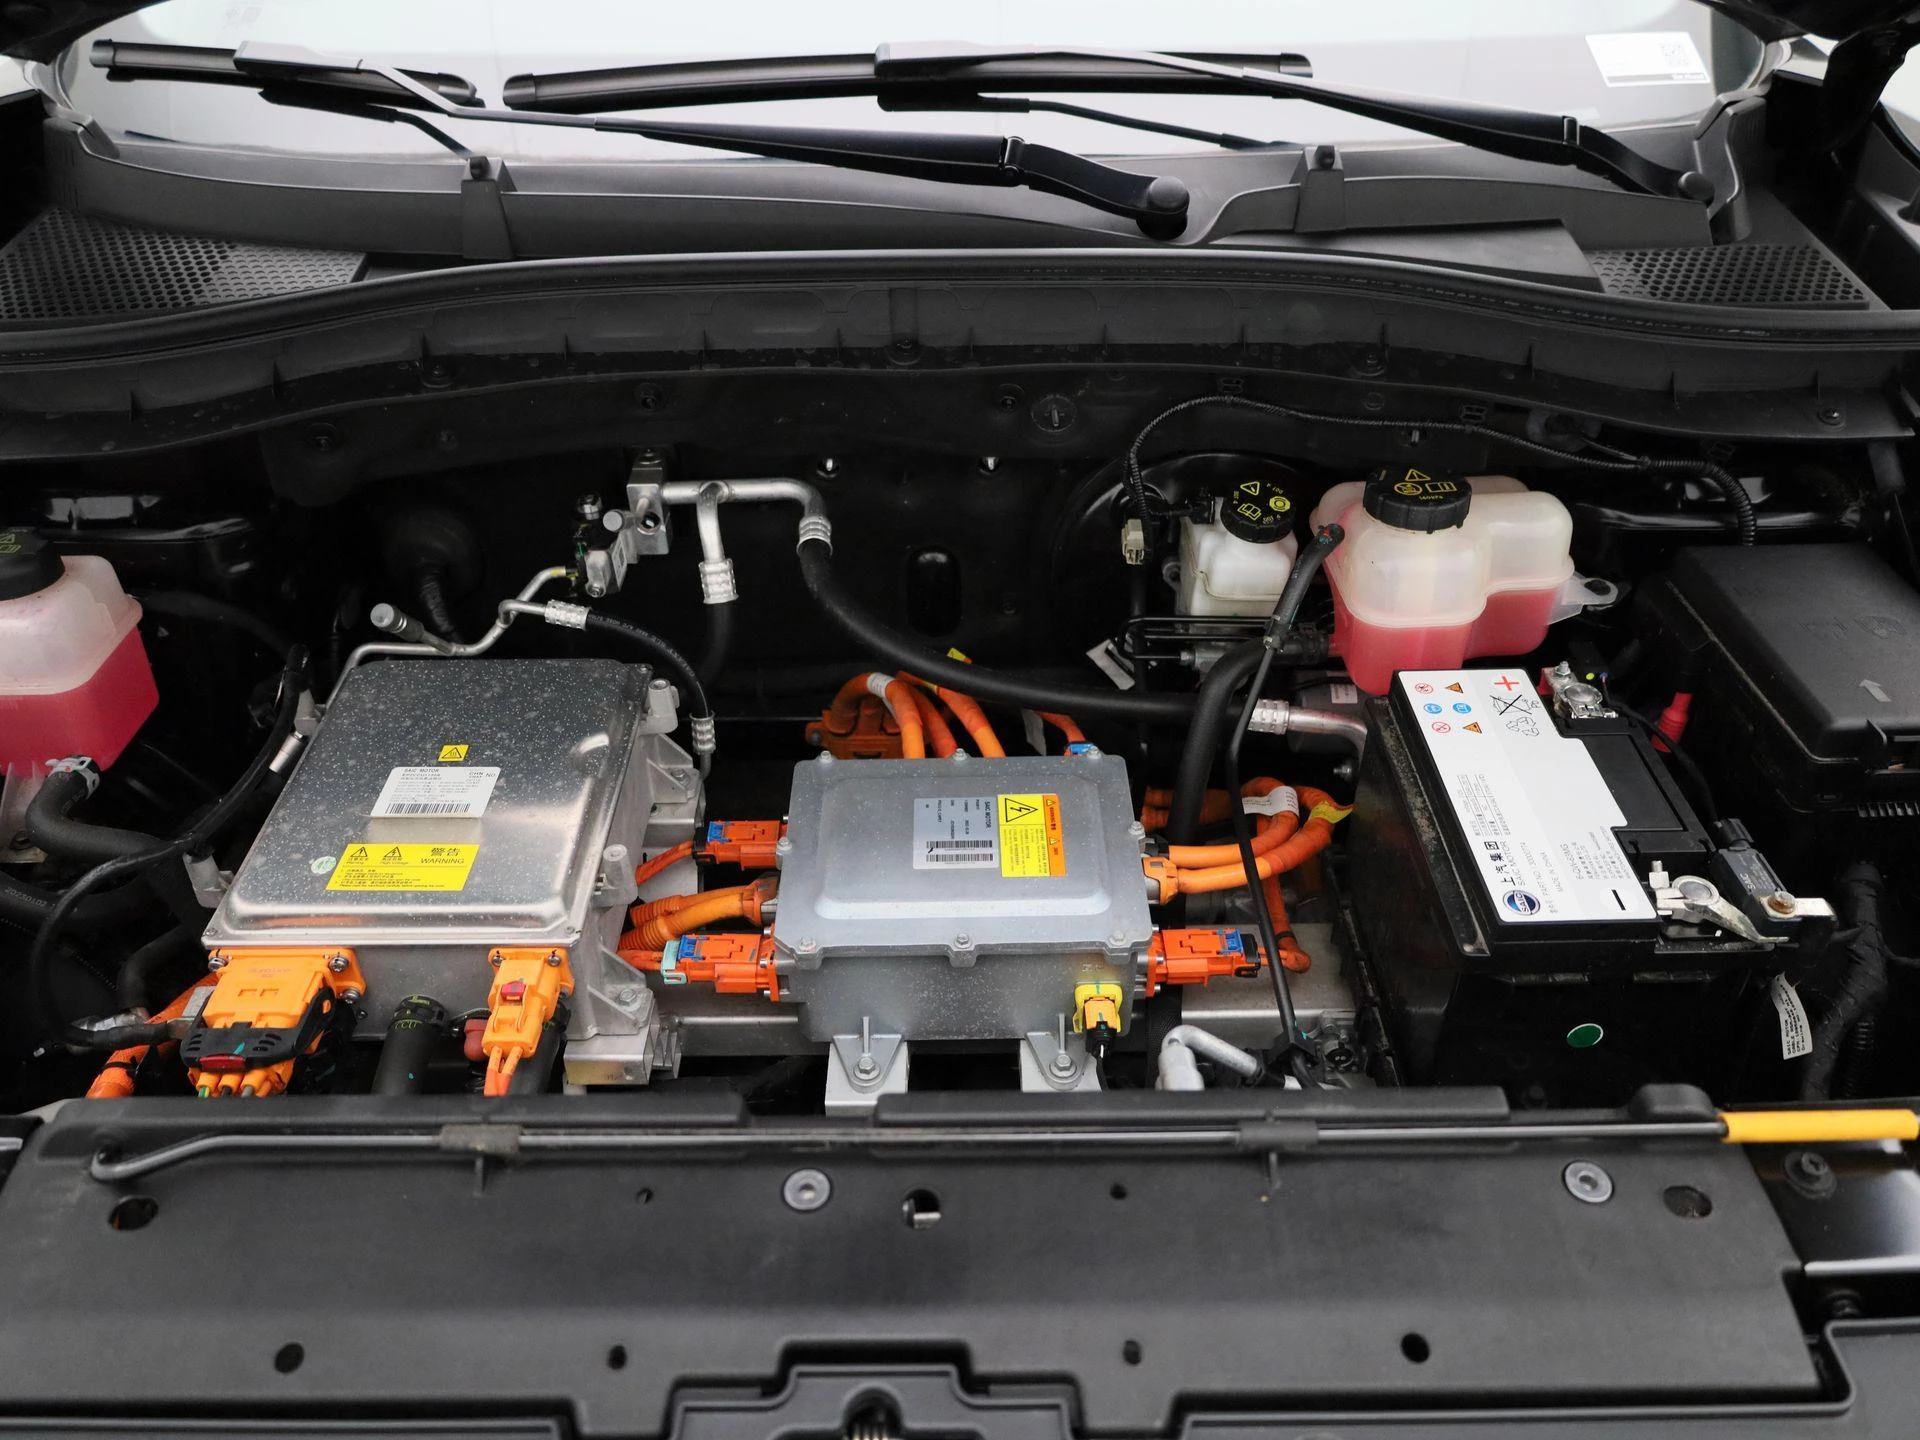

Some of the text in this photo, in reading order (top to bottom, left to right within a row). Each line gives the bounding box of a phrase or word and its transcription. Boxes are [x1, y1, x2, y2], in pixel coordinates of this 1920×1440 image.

[431, 847, 461, 856] 警告
[1484, 841, 1516, 887] 上汽集团
[1499, 840, 1526, 887] SAIC MOTOR
